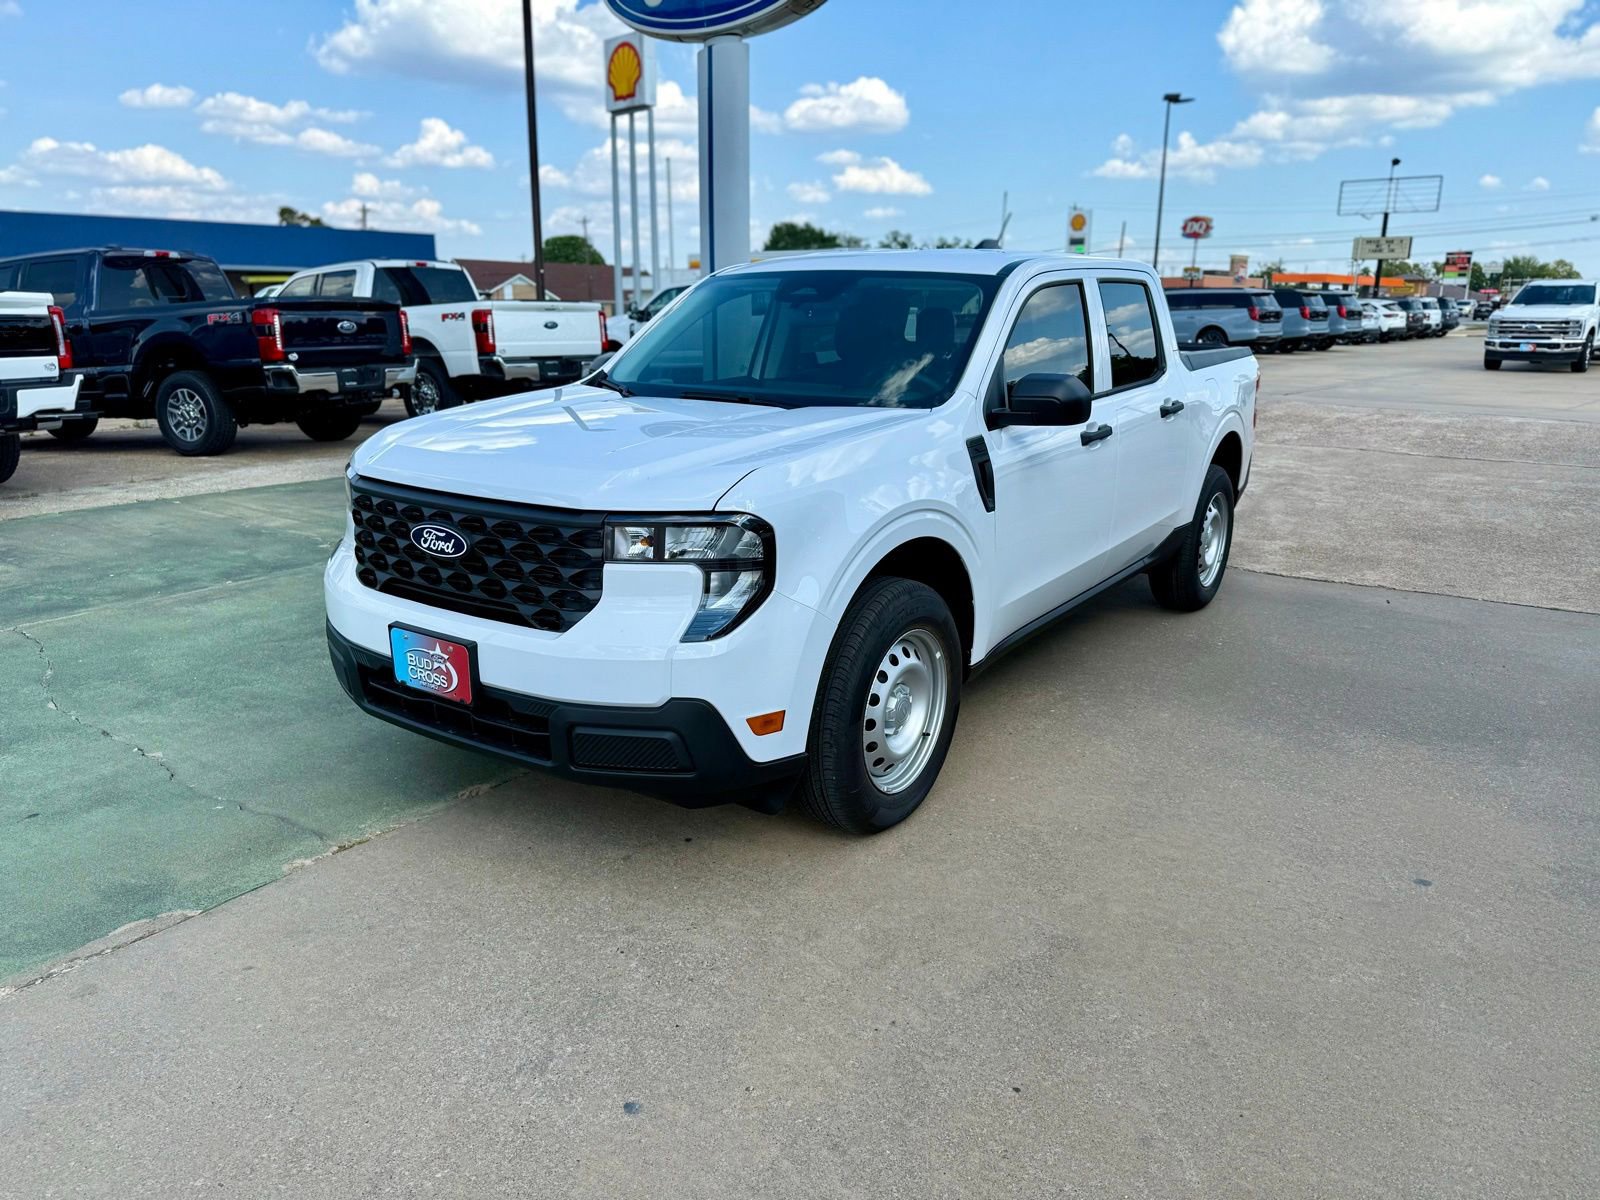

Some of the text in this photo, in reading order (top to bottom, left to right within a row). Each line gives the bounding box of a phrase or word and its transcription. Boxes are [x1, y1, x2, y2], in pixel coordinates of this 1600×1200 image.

[1186, 220, 1207, 234] DQ
[207, 311, 241, 325] FX4
[441, 311, 465, 322] FX4
[421, 528, 455, 554] Ford
[407, 653, 432, 670] BUD
[408, 665, 448, 688] CROSS
